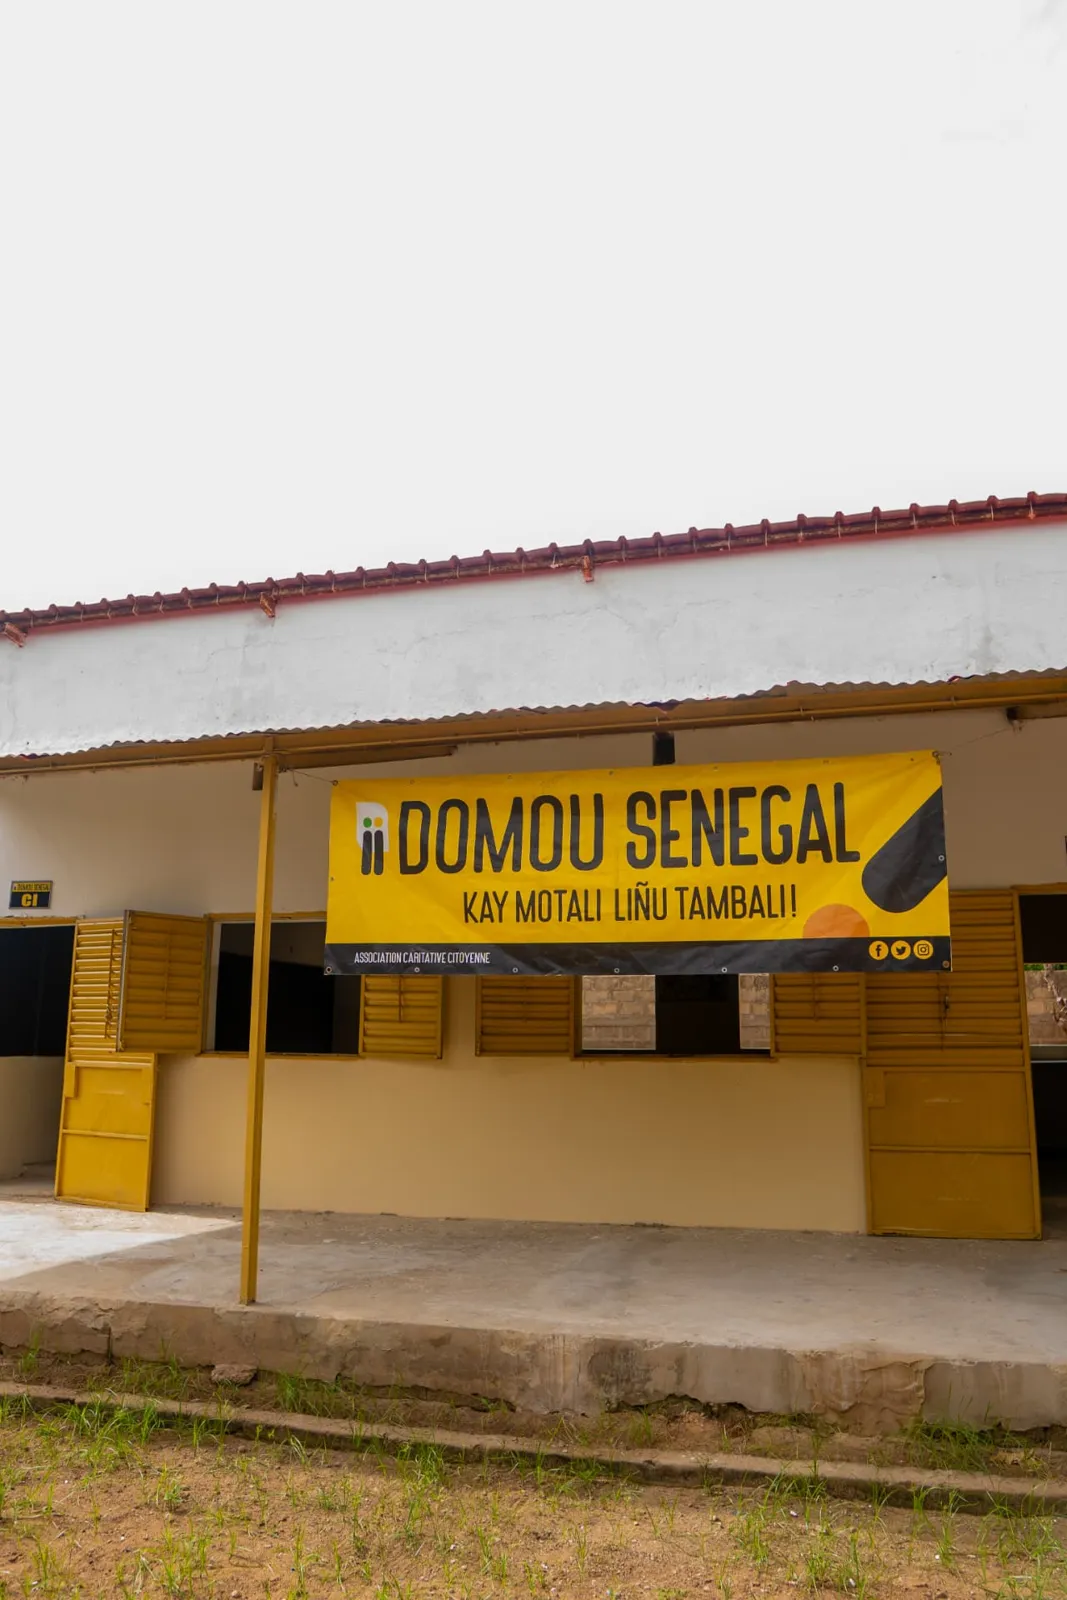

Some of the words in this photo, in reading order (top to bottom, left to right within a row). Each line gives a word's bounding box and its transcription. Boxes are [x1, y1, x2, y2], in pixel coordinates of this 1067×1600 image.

[399, 793, 604, 875] DOMOU
[626, 782, 861, 869] SENEGAL
[463, 890, 509, 923] KAY
[515, 888, 601, 923] MOTALI
[614, 881, 667, 922] LIÑU
[674, 884, 797, 920] TAMBALI!
[354, 951, 401, 964] ASSOCIATION
[402, 951, 447, 964] CARITATIVE
[447, 951, 491, 964] CITOYENNE
